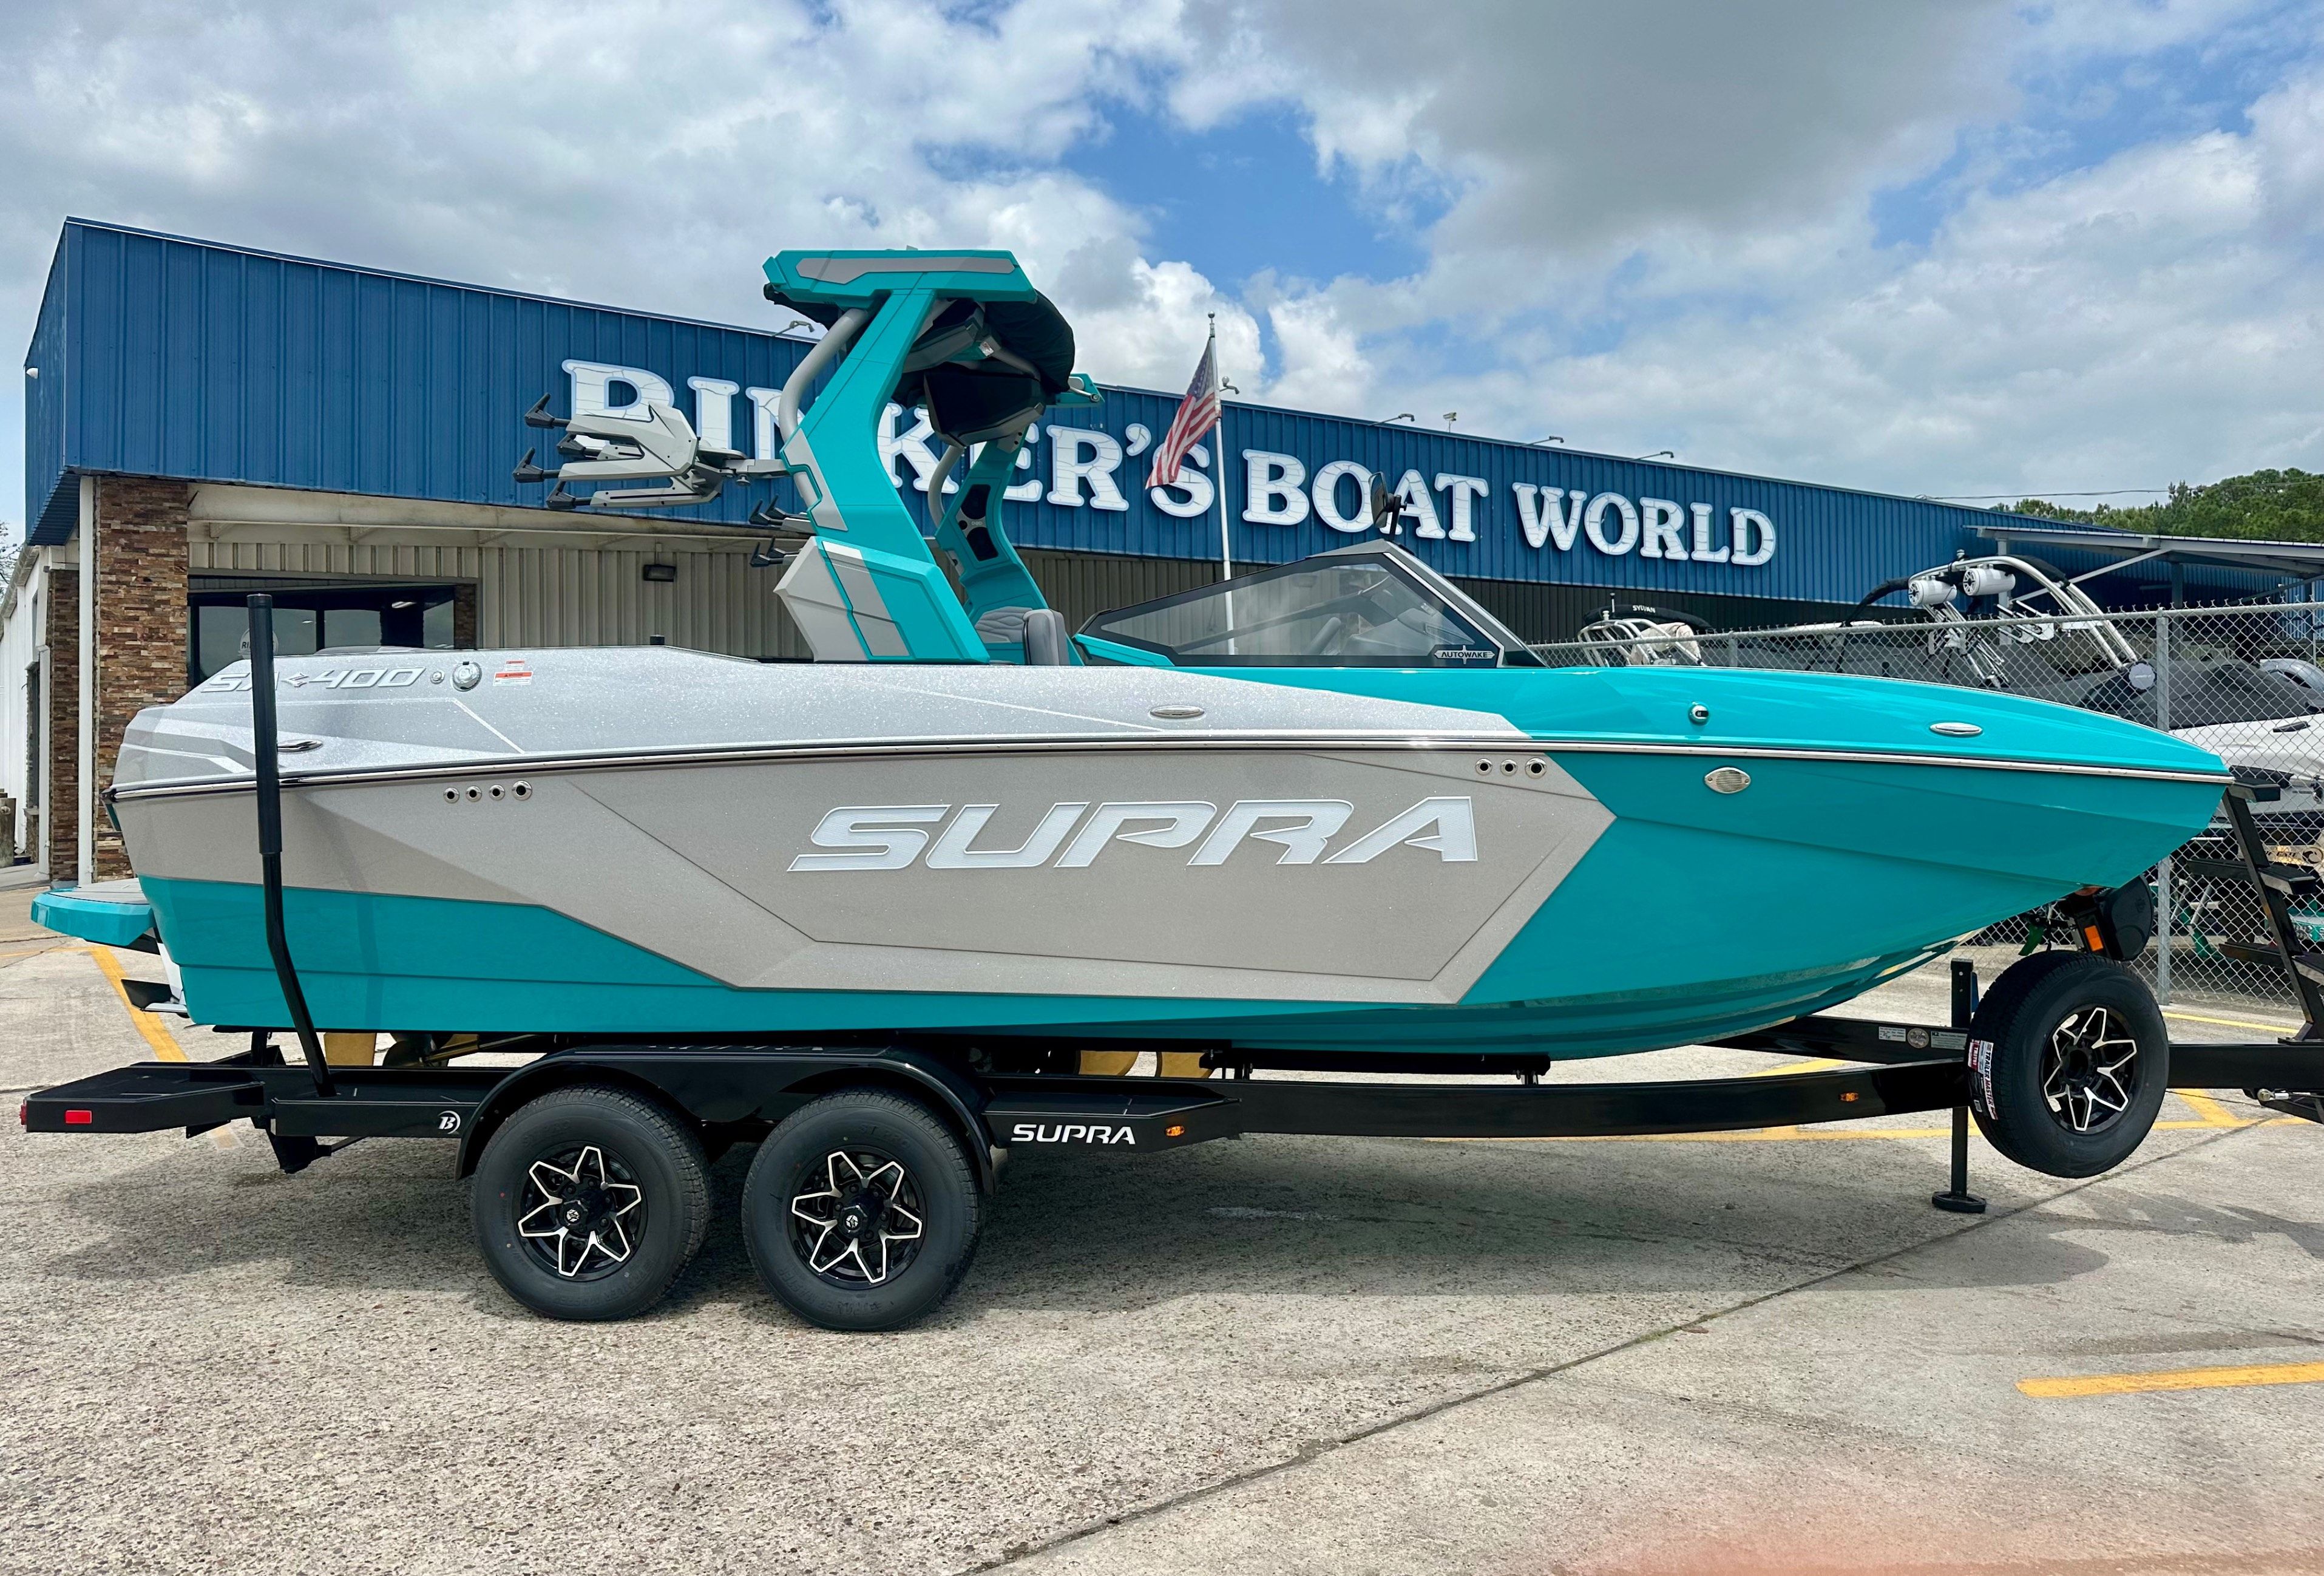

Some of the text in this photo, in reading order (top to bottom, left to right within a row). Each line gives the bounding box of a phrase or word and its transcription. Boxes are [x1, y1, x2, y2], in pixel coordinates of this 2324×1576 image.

[1243, 449, 1489, 542] BOAT
[1513, 482, 1776, 566] WORLD
[1633, 605, 1656, 614] SYLVAN
[201, 667, 426, 693] S 400
[787, 796, 1478, 871] SUPRA
[1011, 1124, 1136, 1144] SUPRA
